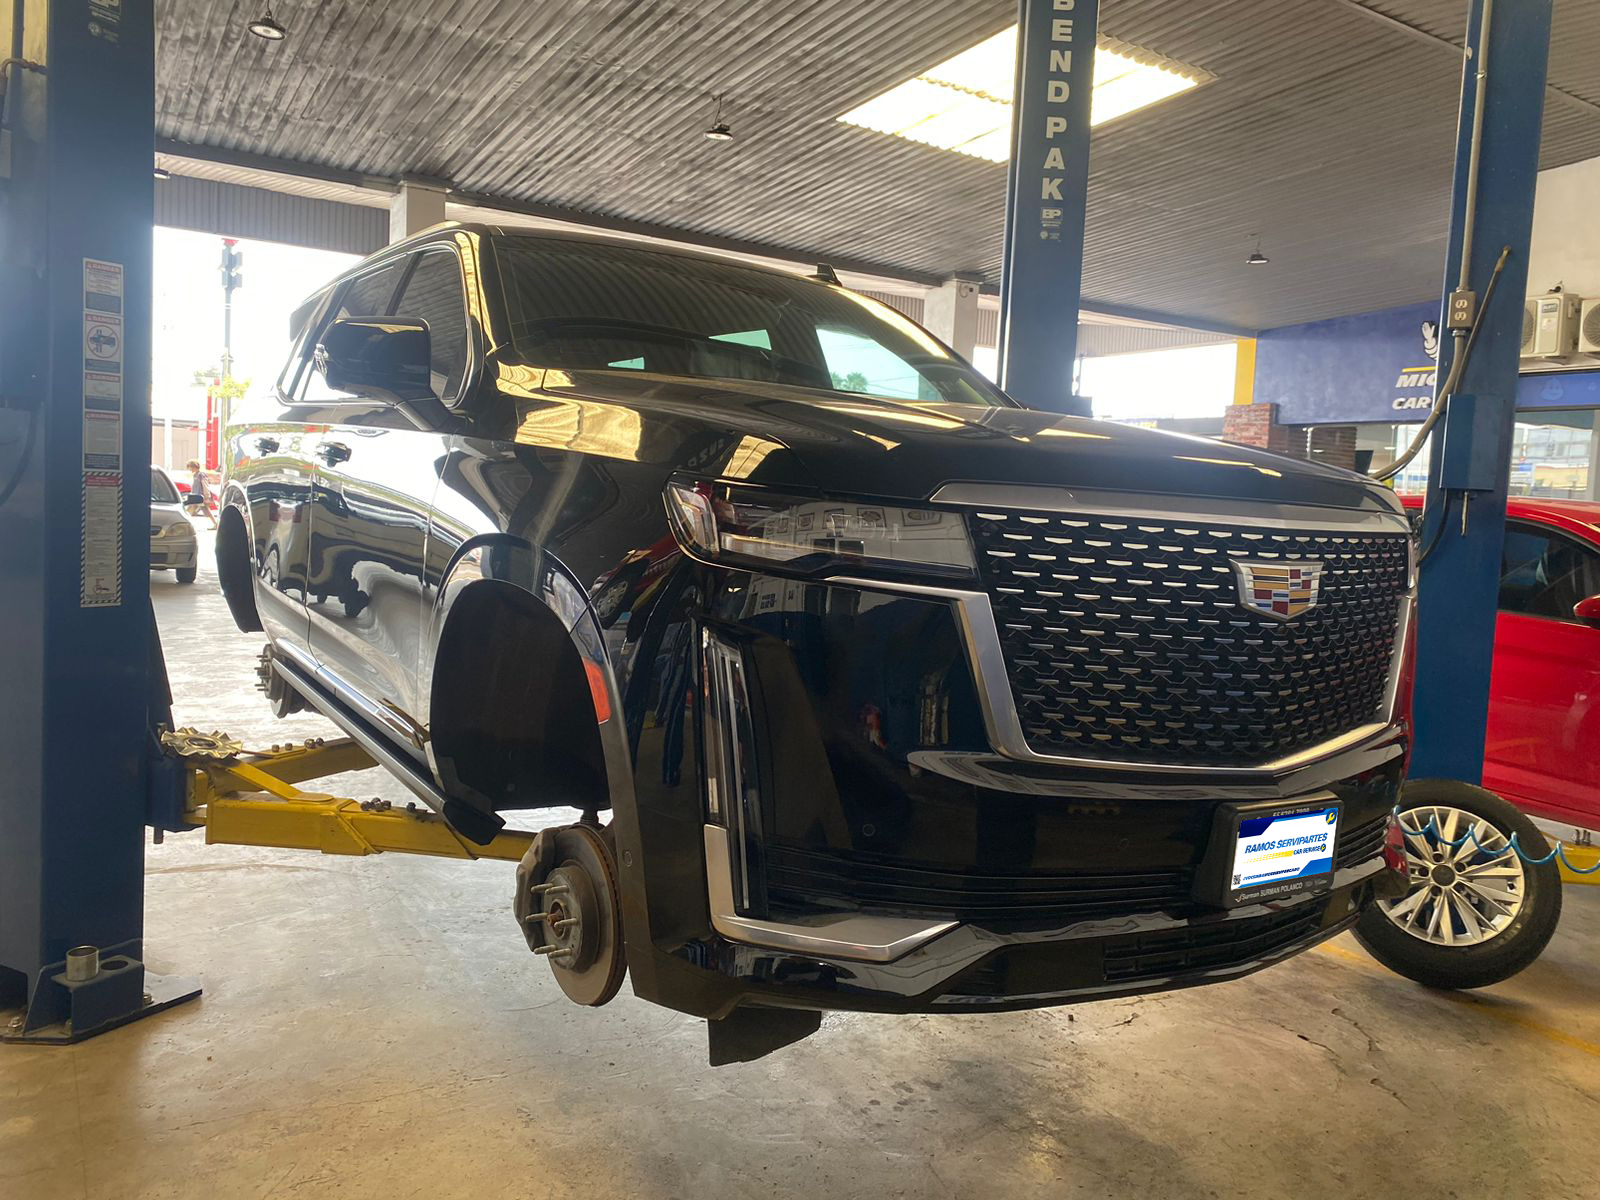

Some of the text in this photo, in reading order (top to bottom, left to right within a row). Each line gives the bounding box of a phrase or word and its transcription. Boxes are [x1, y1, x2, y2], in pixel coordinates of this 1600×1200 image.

[1392, 397, 1432, 410] CAR
[1260, 887, 1280, 897] SURMAN
[1280, 882, 1303, 893] POLANCO
